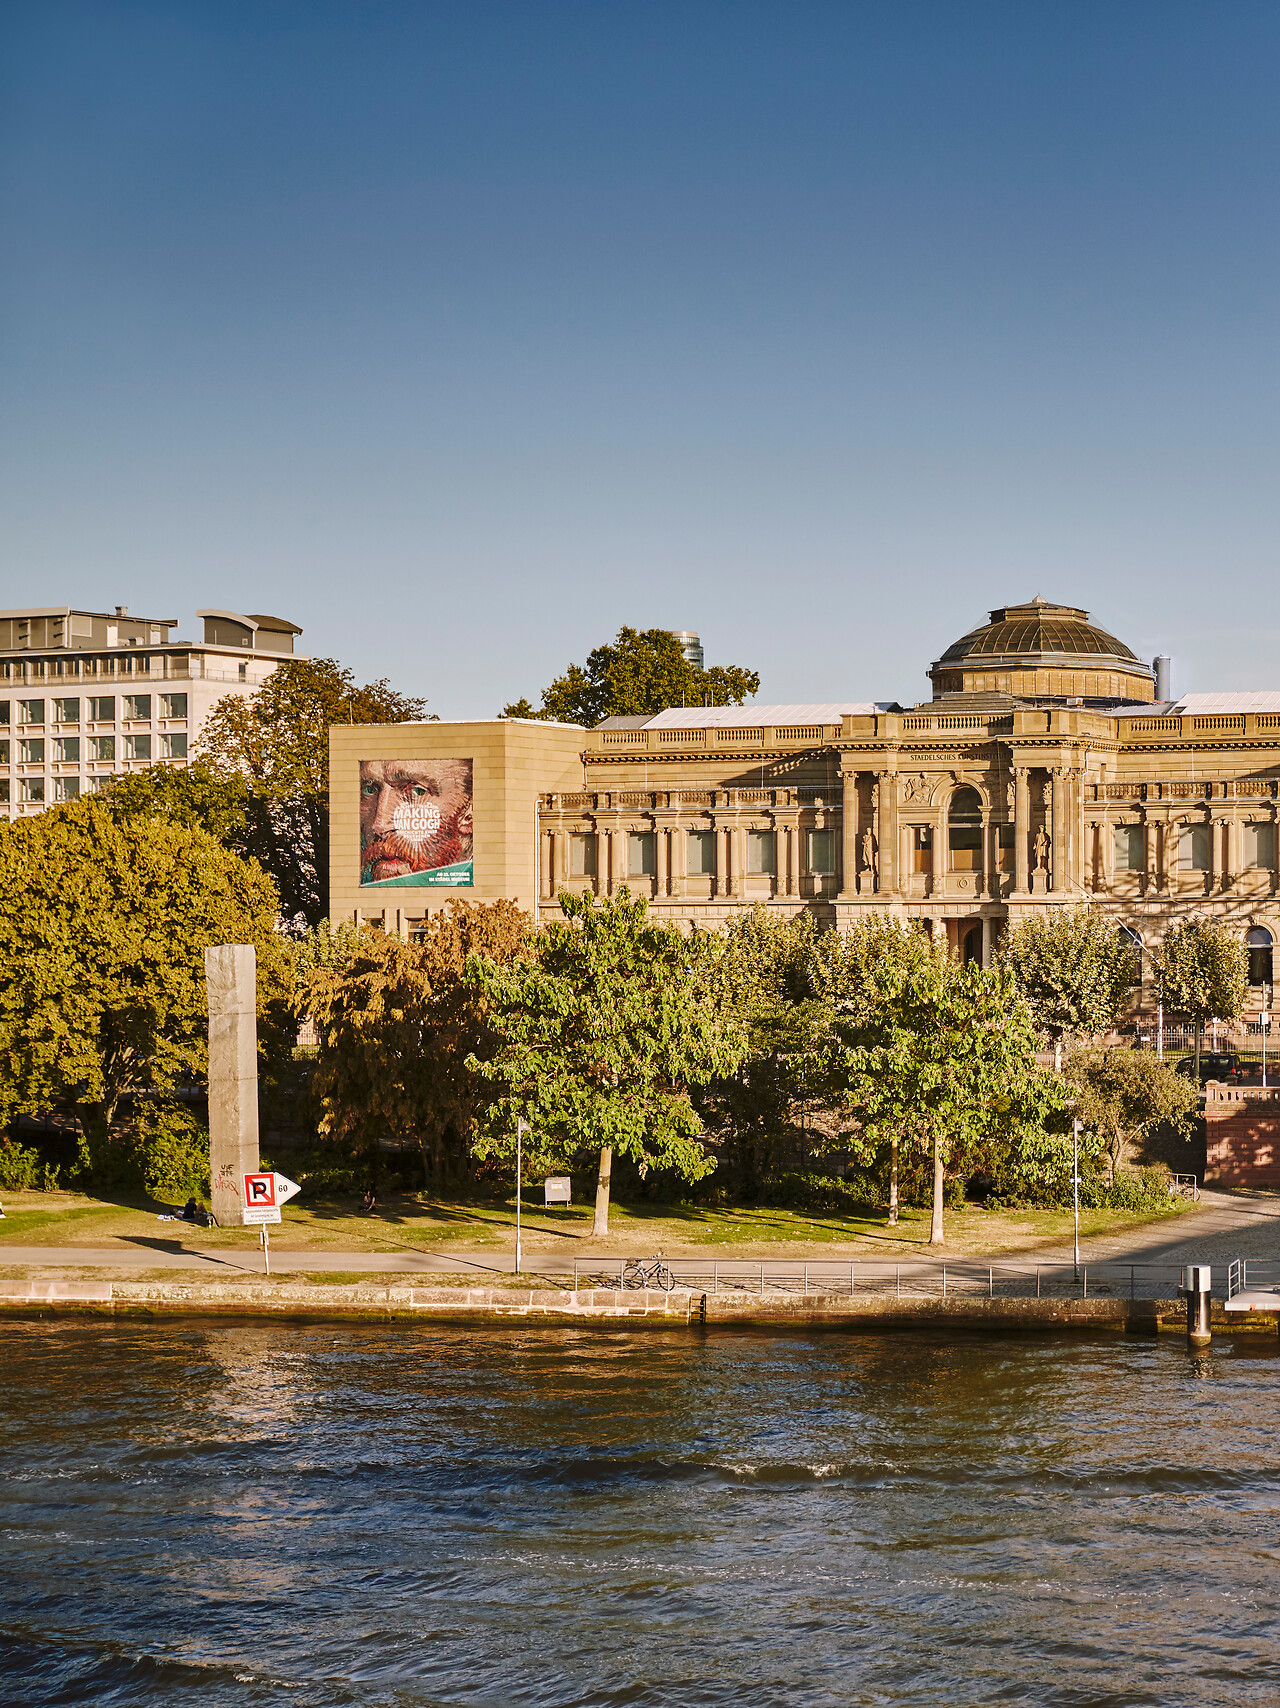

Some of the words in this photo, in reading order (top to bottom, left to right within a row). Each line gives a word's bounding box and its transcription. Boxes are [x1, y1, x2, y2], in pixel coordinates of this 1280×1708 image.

[393, 808, 440, 819] MAKING
[393, 818, 410, 830] VAN
[411, 818, 440, 830] GOGH
[253, 1182, 267, 1199] P
[278, 1184, 288, 1193] 60
